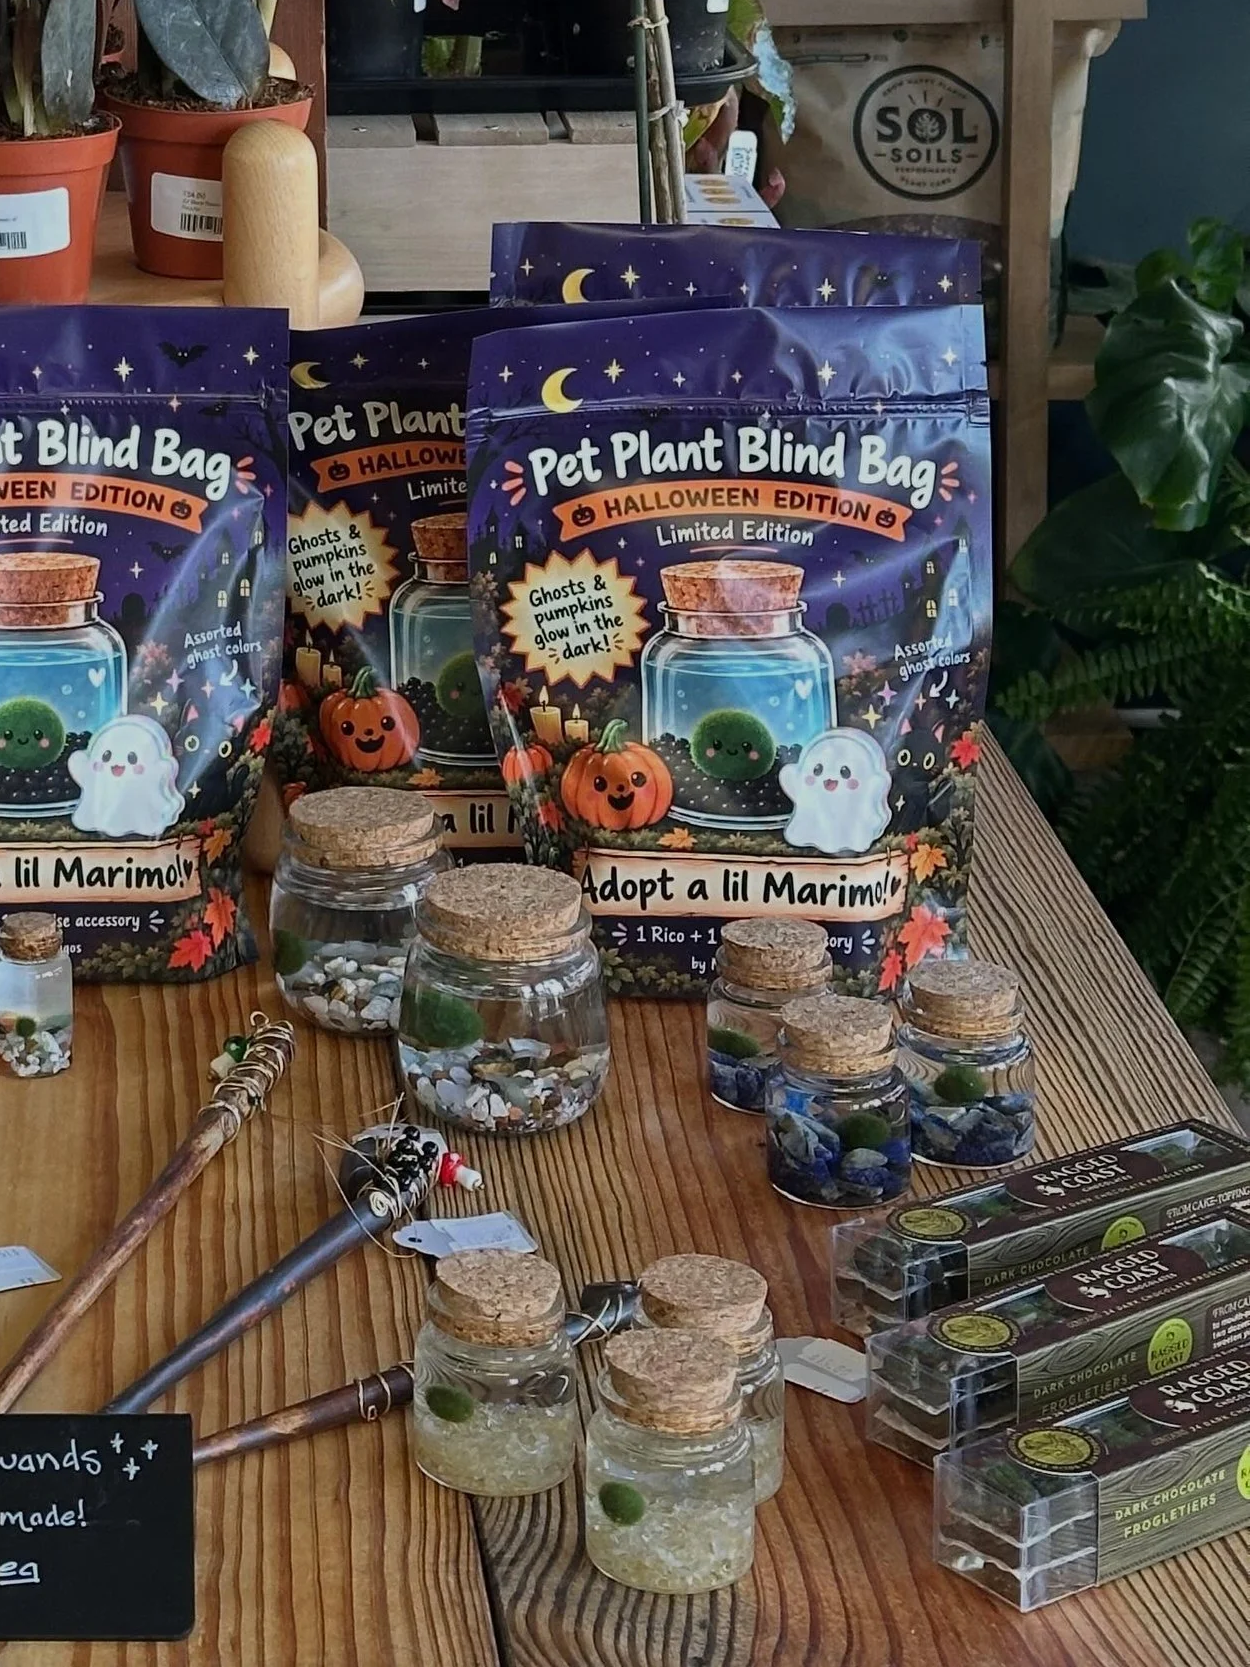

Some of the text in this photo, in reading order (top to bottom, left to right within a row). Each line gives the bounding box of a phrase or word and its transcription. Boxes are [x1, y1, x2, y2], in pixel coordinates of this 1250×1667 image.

[876, 106, 978, 144] SOL
[890, 147, 963, 164] SOILS
[288, 401, 467, 451] Pet Plant
[37, 419, 140, 471] Blind
[150, 427, 232, 501] Bag
[358, 446, 466, 476] HALLOWE
[528, 426, 937, 509] Pet Plant Blind Bag
[70, 482, 166, 513] EDITION
[408, 478, 467, 501] Limite
[604, 487, 871, 522] HALLOWEEN EDITION
[39, 512, 109, 538] Edition
[288, 524, 362, 555] Ghosts &
[656, 520, 815, 547] Limited Edition
[292, 543, 367, 576] pumpkins
[292, 559, 376, 597] glow in the
[316, 581, 363, 608] dark!
[529, 574, 607, 608] Ghosts &
[534, 595, 614, 630] pumpkins
[184, 620, 242, 649] Assorted
[534, 612, 624, 651] glow in the
[894, 631, 953, 662] Assorted
[187, 636, 263, 670] ghost colors
[562, 636, 612, 661] dark!
[899, 652, 971, 682] ghost colors
[469, 802, 496, 834] lil
[15, 857, 40, 889] lil
[53, 855, 185, 890] Marimo!
[581, 864, 890, 910] Adopt a lil Marimo!
[76, 914, 141, 936] accessory
[637, 925, 718, 945] 1 Rico + 1
[691, 956, 706, 974] by
[1032, 1153, 1119, 1184] RAGGED
[1061, 1164, 1127, 1190] COAST
[984, 1246, 1090, 1286] DARK CHOCOLATE
[1072, 1248, 1160, 1284] RAGGED
[1103, 1260, 1171, 1290] COAST
[1033, 1351, 1139, 1400] DARK CHOCOLATE
[1158, 1360, 1250, 1397] RAGGED
[1041, 1373, 1129, 1416] FROGLETIERS
[1115, 1498, 1149, 1522] DARK
[1152, 1469, 1227, 1507] CHOCOLATE
[0, 1498, 87, 1532] made!
[1123, 1492, 1218, 1540] FROGLETIERS
